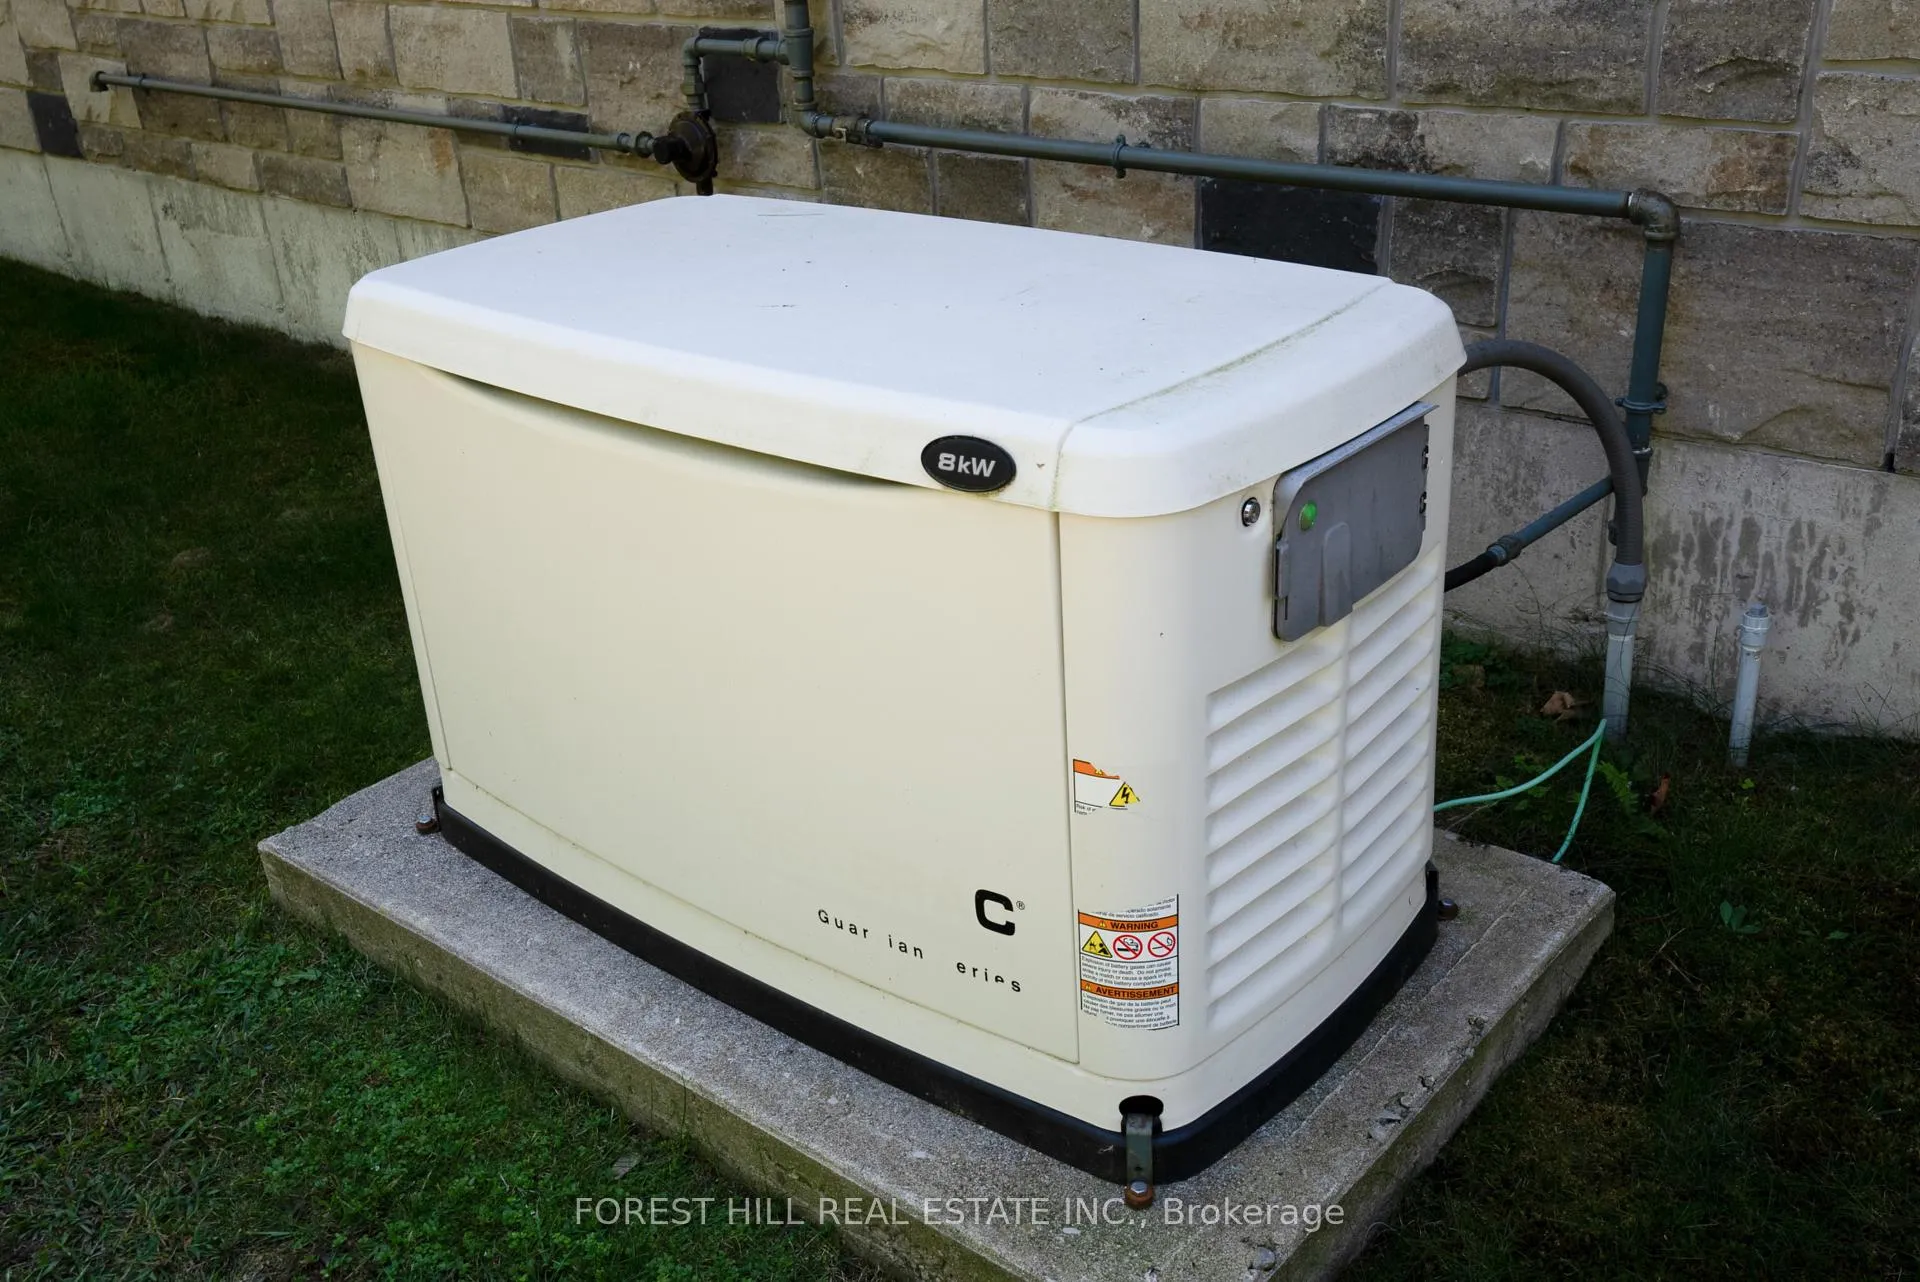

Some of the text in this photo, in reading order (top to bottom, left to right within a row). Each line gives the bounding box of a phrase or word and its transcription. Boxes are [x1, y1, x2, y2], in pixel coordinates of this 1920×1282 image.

[938, 452, 996, 478] 8kW
[1110, 921, 1158, 931] WARNING
[1096, 986, 1174, 999] AVERTISSEMENT
